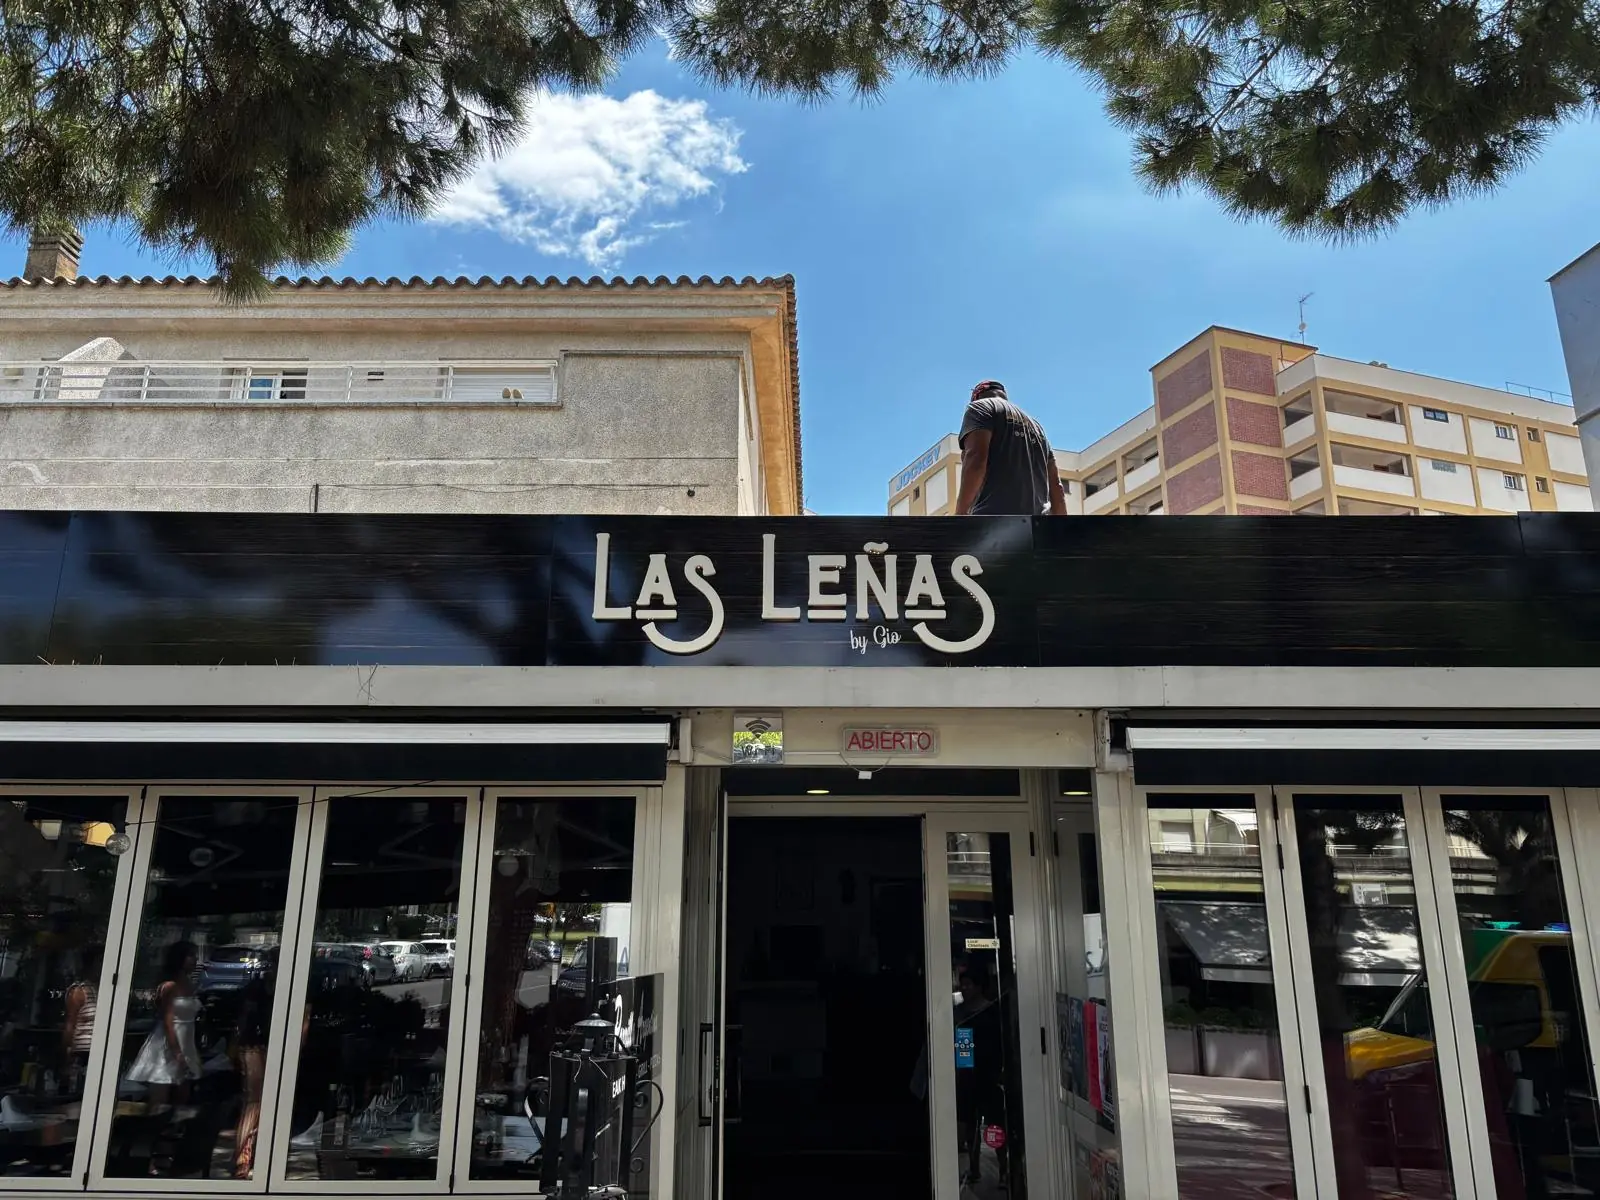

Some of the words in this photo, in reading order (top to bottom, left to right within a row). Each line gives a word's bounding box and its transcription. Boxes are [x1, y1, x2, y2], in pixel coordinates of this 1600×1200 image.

[592, 532, 725, 654] LAS
[761, 533, 996, 654] LEÑAS
[849, 629, 868, 655] by
[873, 625, 902, 648] Gio
[848, 731, 932, 751] ABIERTO
